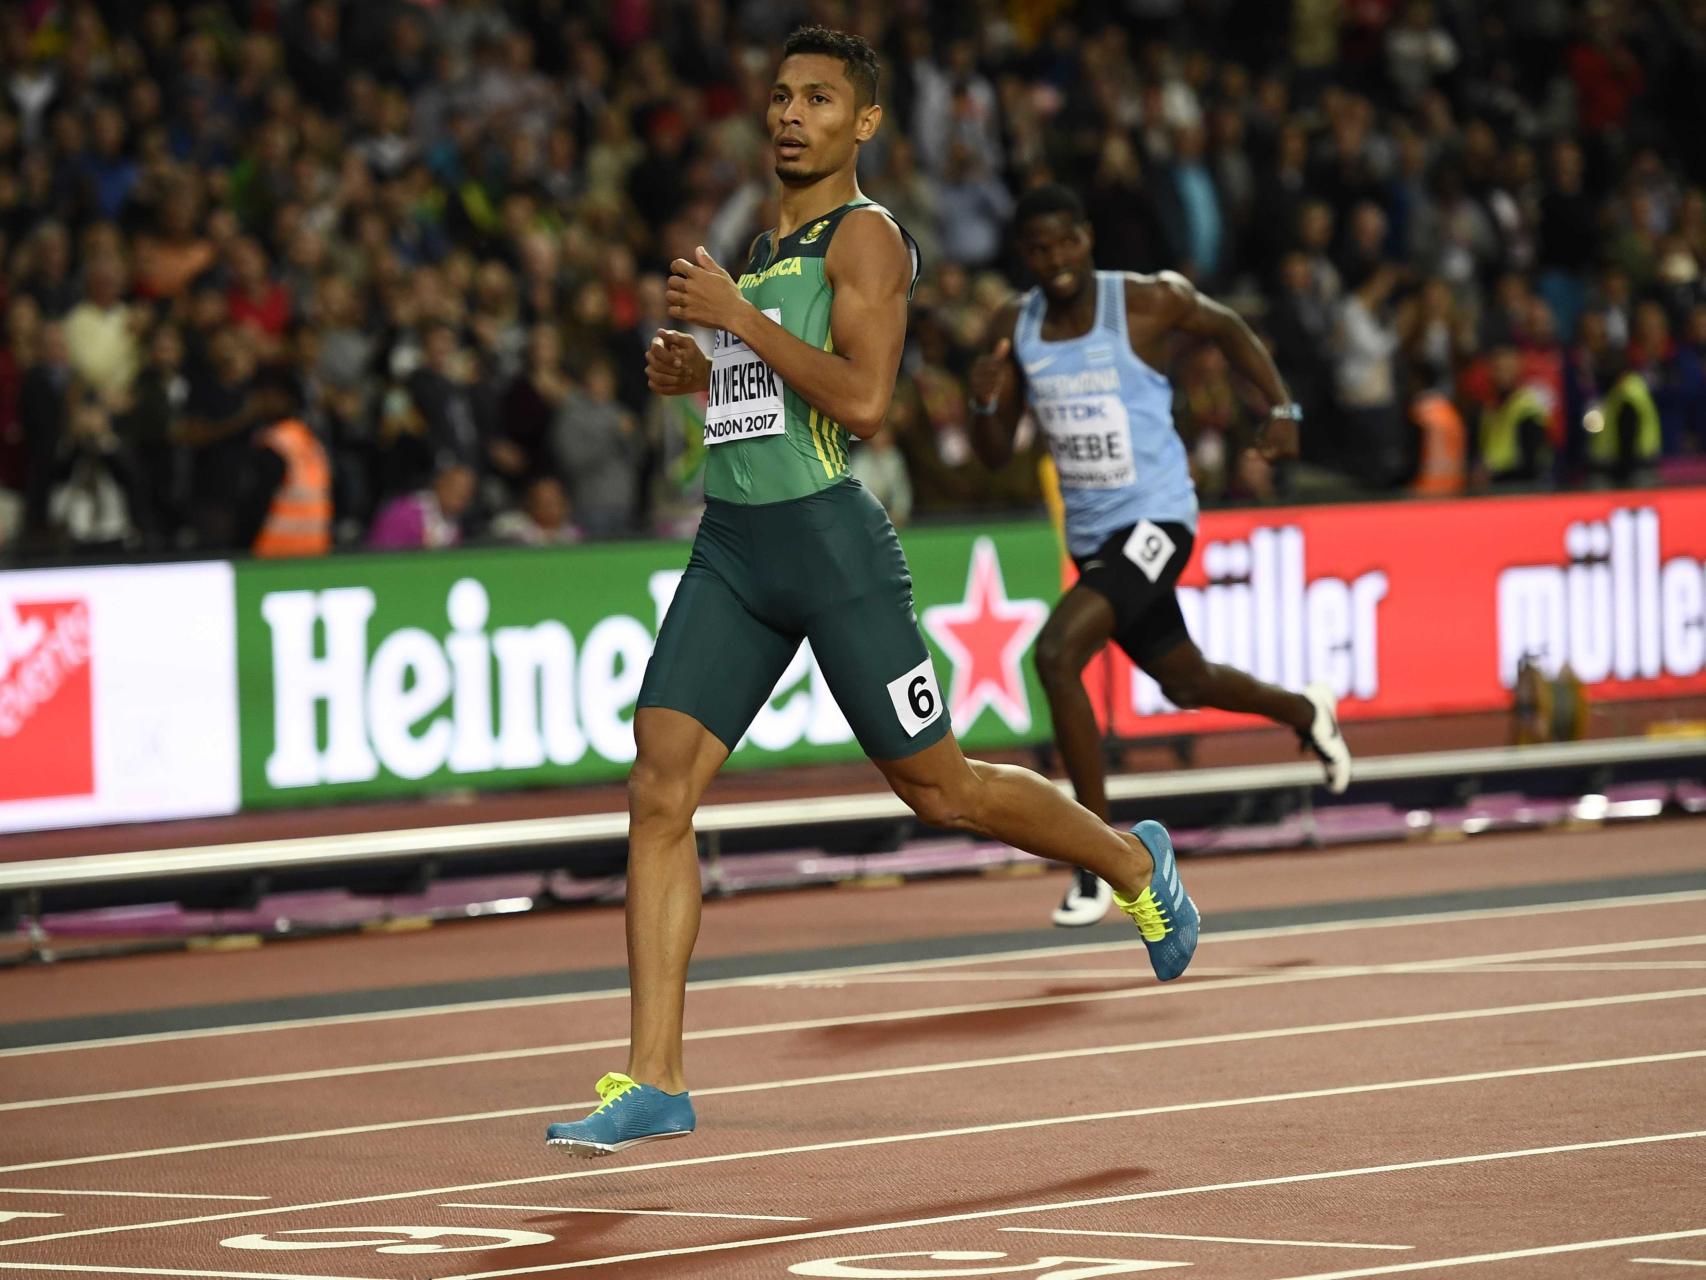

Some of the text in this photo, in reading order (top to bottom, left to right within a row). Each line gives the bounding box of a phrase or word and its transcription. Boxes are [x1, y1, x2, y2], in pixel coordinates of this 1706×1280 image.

[722, 361, 779, 405] NIEKERK
[745, 413, 778, 433] 2017
[1140, 534, 1163, 562] 9
[1496, 506, 1706, 690] mülle
[907, 675, 935, 719] 6
